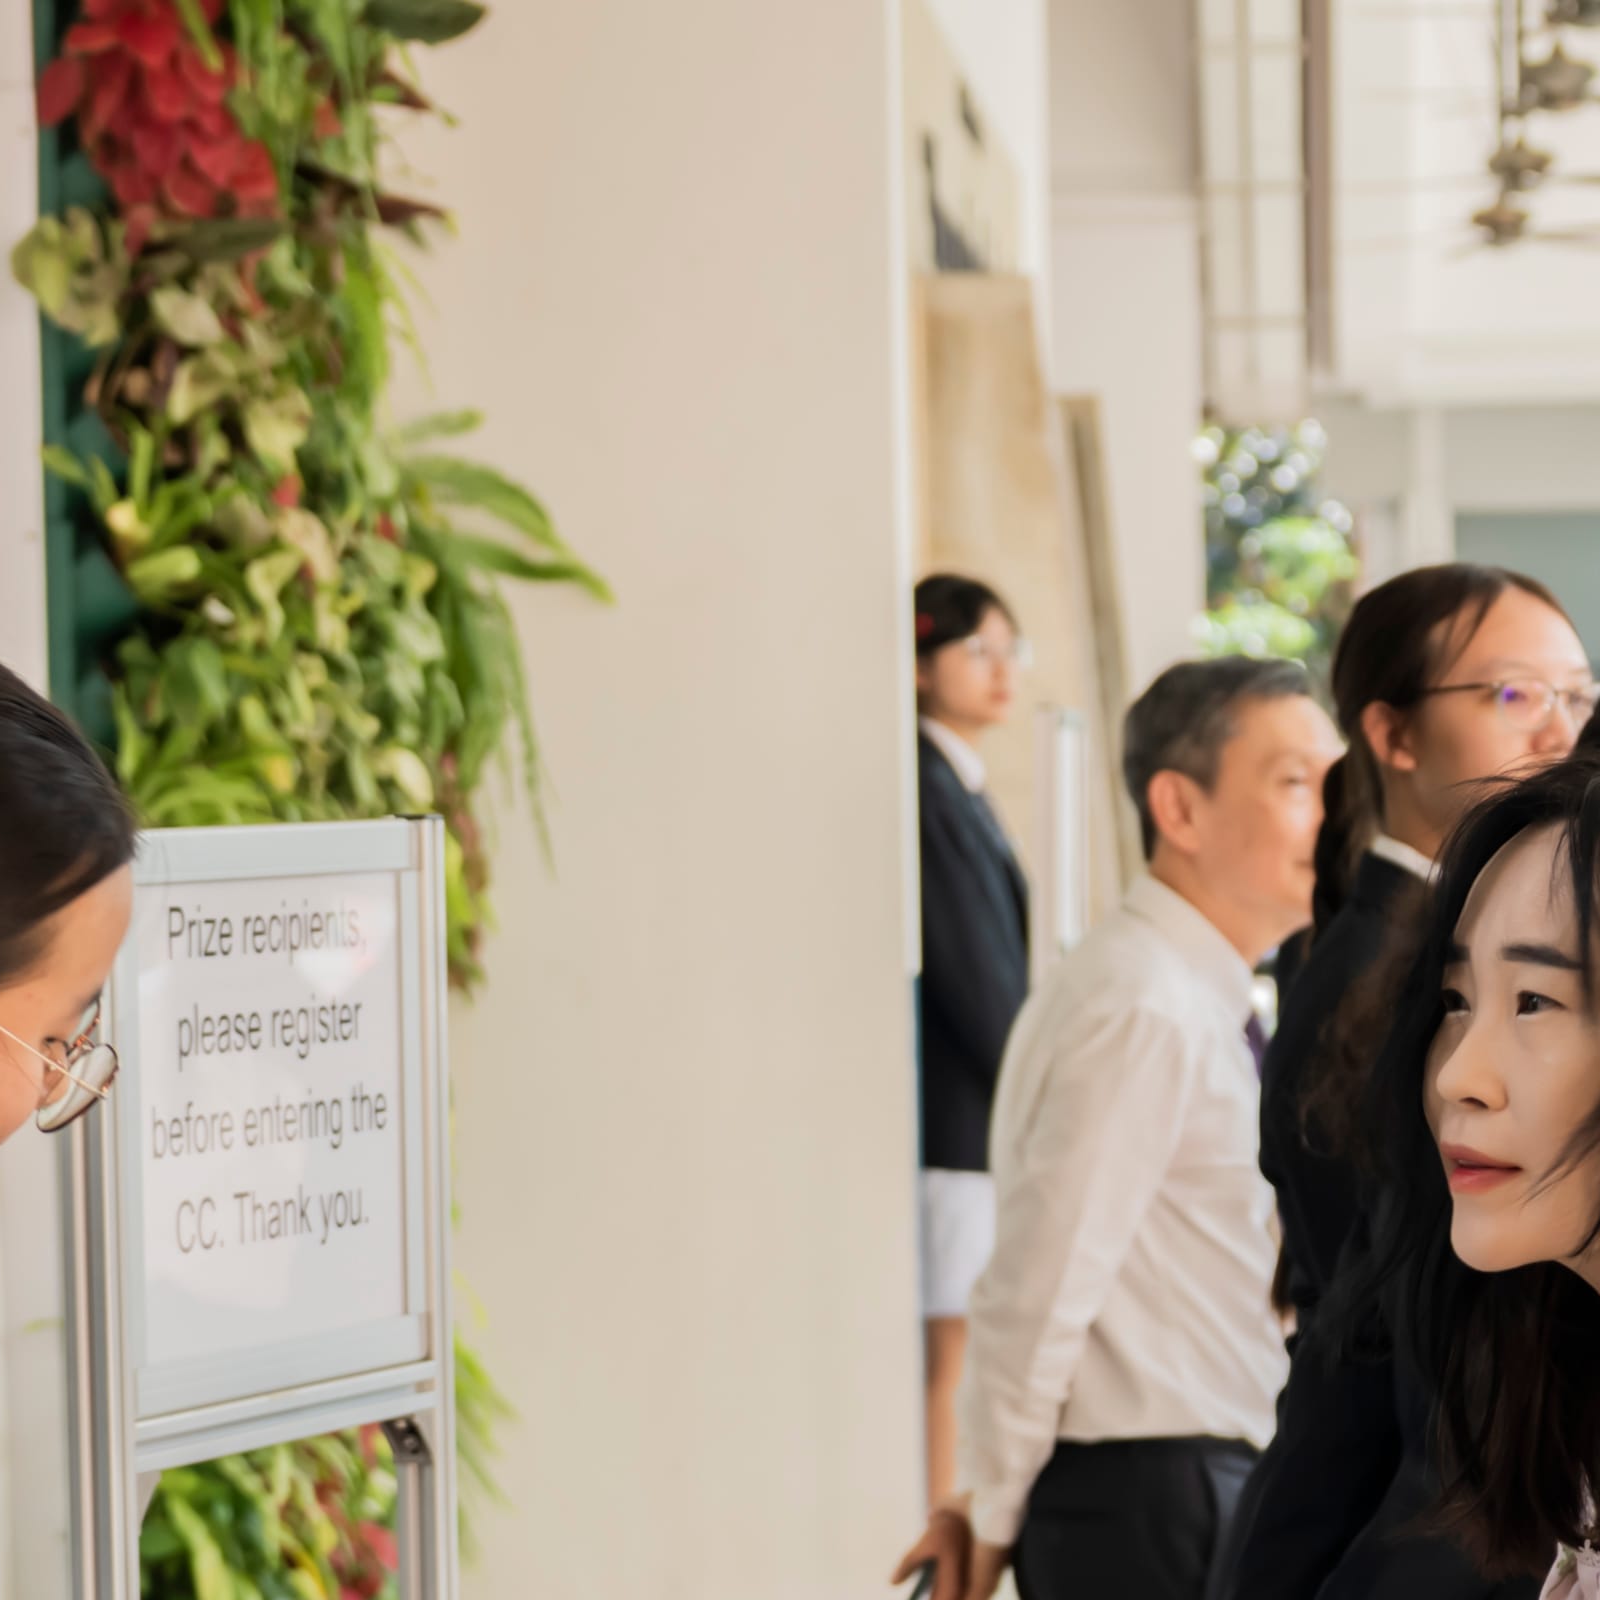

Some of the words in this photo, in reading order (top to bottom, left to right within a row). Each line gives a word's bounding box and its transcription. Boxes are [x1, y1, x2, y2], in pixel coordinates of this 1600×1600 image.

[168, 904, 233, 960] Prize
[243, 899, 368, 967] recipients,
[178, 1001, 262, 1073] please
[271, 992, 363, 1060] register
[151, 1100, 233, 1160] before
[243, 1087, 343, 1151] entering
[351, 1080, 388, 1133] the
[175, 1196, 225, 1255] CC.
[233, 1183, 313, 1245] Thank
[319, 1187, 370, 1246] you.
